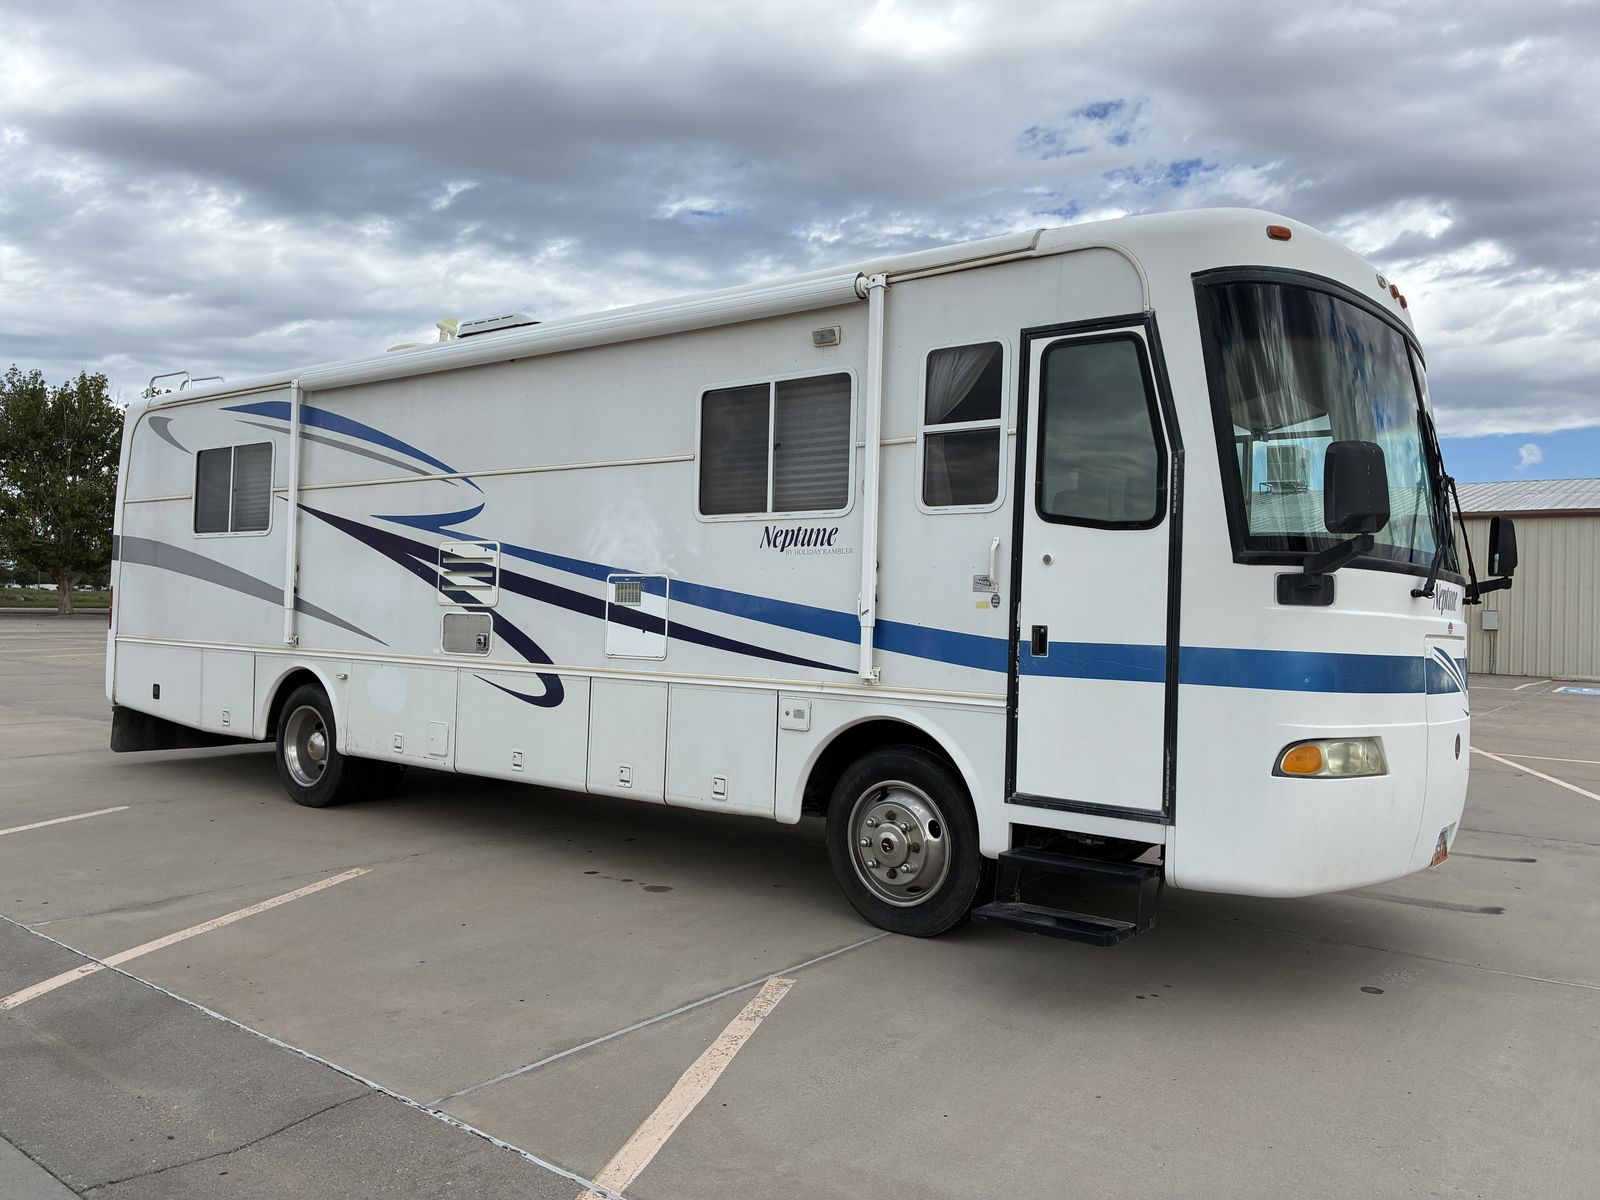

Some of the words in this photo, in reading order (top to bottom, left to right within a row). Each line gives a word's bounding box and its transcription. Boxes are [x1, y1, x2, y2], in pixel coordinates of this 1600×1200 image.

[759, 525, 839, 552] Neptune
[794, 548, 821, 556] HOLIDAY
[822, 547, 854, 555] RAMBLER
